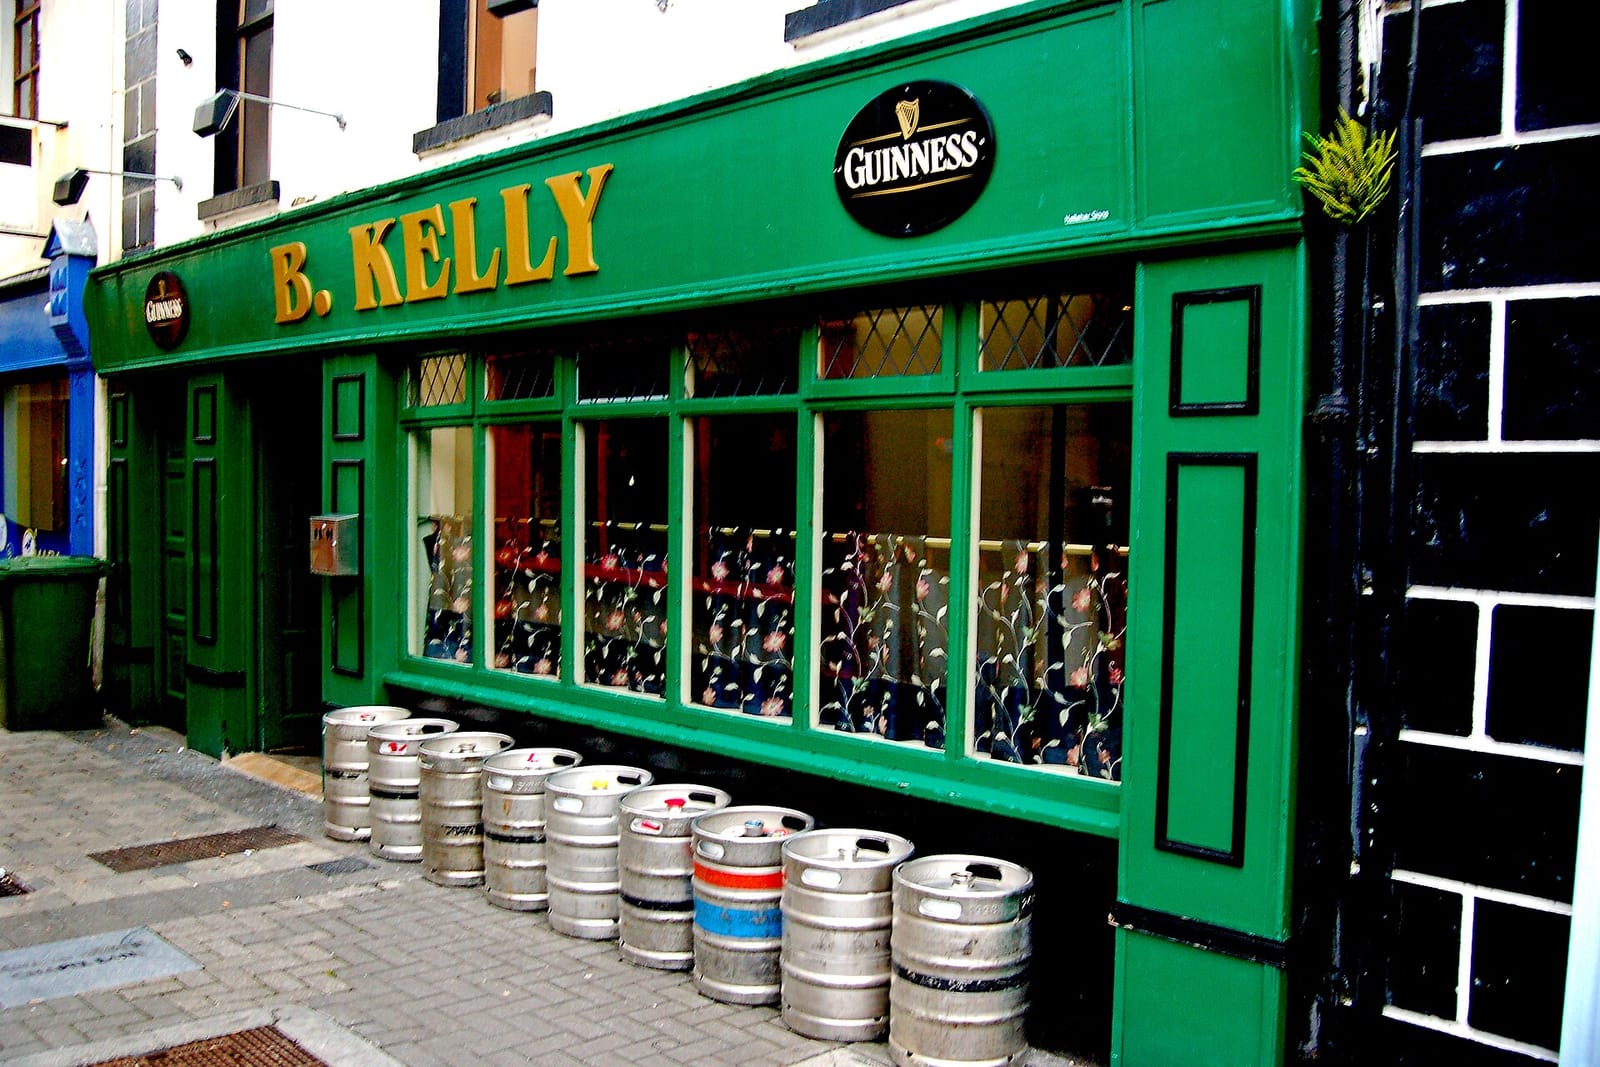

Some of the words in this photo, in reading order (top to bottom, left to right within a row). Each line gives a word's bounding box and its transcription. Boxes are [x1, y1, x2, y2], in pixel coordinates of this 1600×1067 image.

[843, 130, 979, 190] GUINNESS
[270, 241, 333, 324] B.
[349, 163, 614, 311] KELLY
[145, 298, 183, 323] GUINNESS
